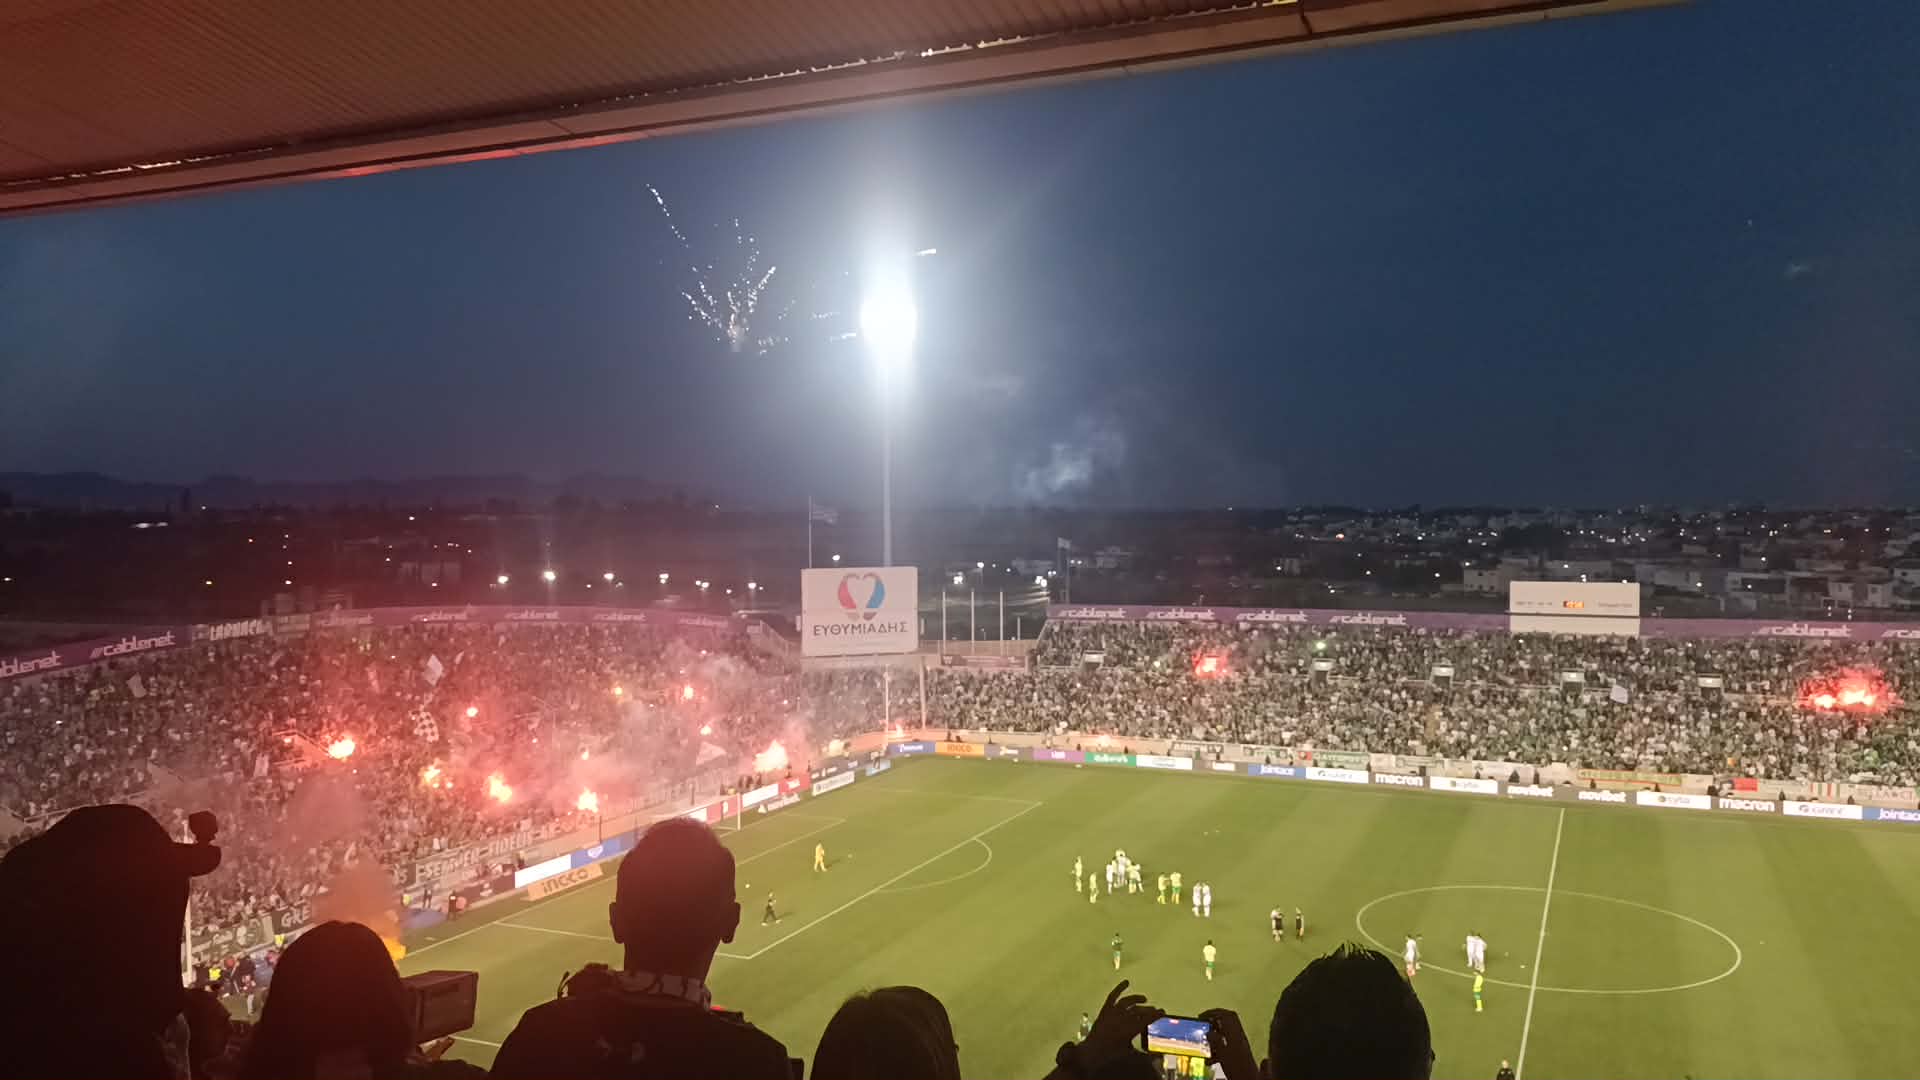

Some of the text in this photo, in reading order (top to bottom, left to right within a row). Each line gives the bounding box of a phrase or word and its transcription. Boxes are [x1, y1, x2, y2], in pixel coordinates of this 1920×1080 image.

[813, 621, 909, 637] ΕΥΘΥΜΙΑΔΗΣ
[1771, 623, 1852, 638] cablenet
[103, 631, 176, 656] cablenet
[1375, 773, 1424, 787] macron
[1578, 790, 1626, 803] novibet
[1719, 800, 1775, 812] macron
